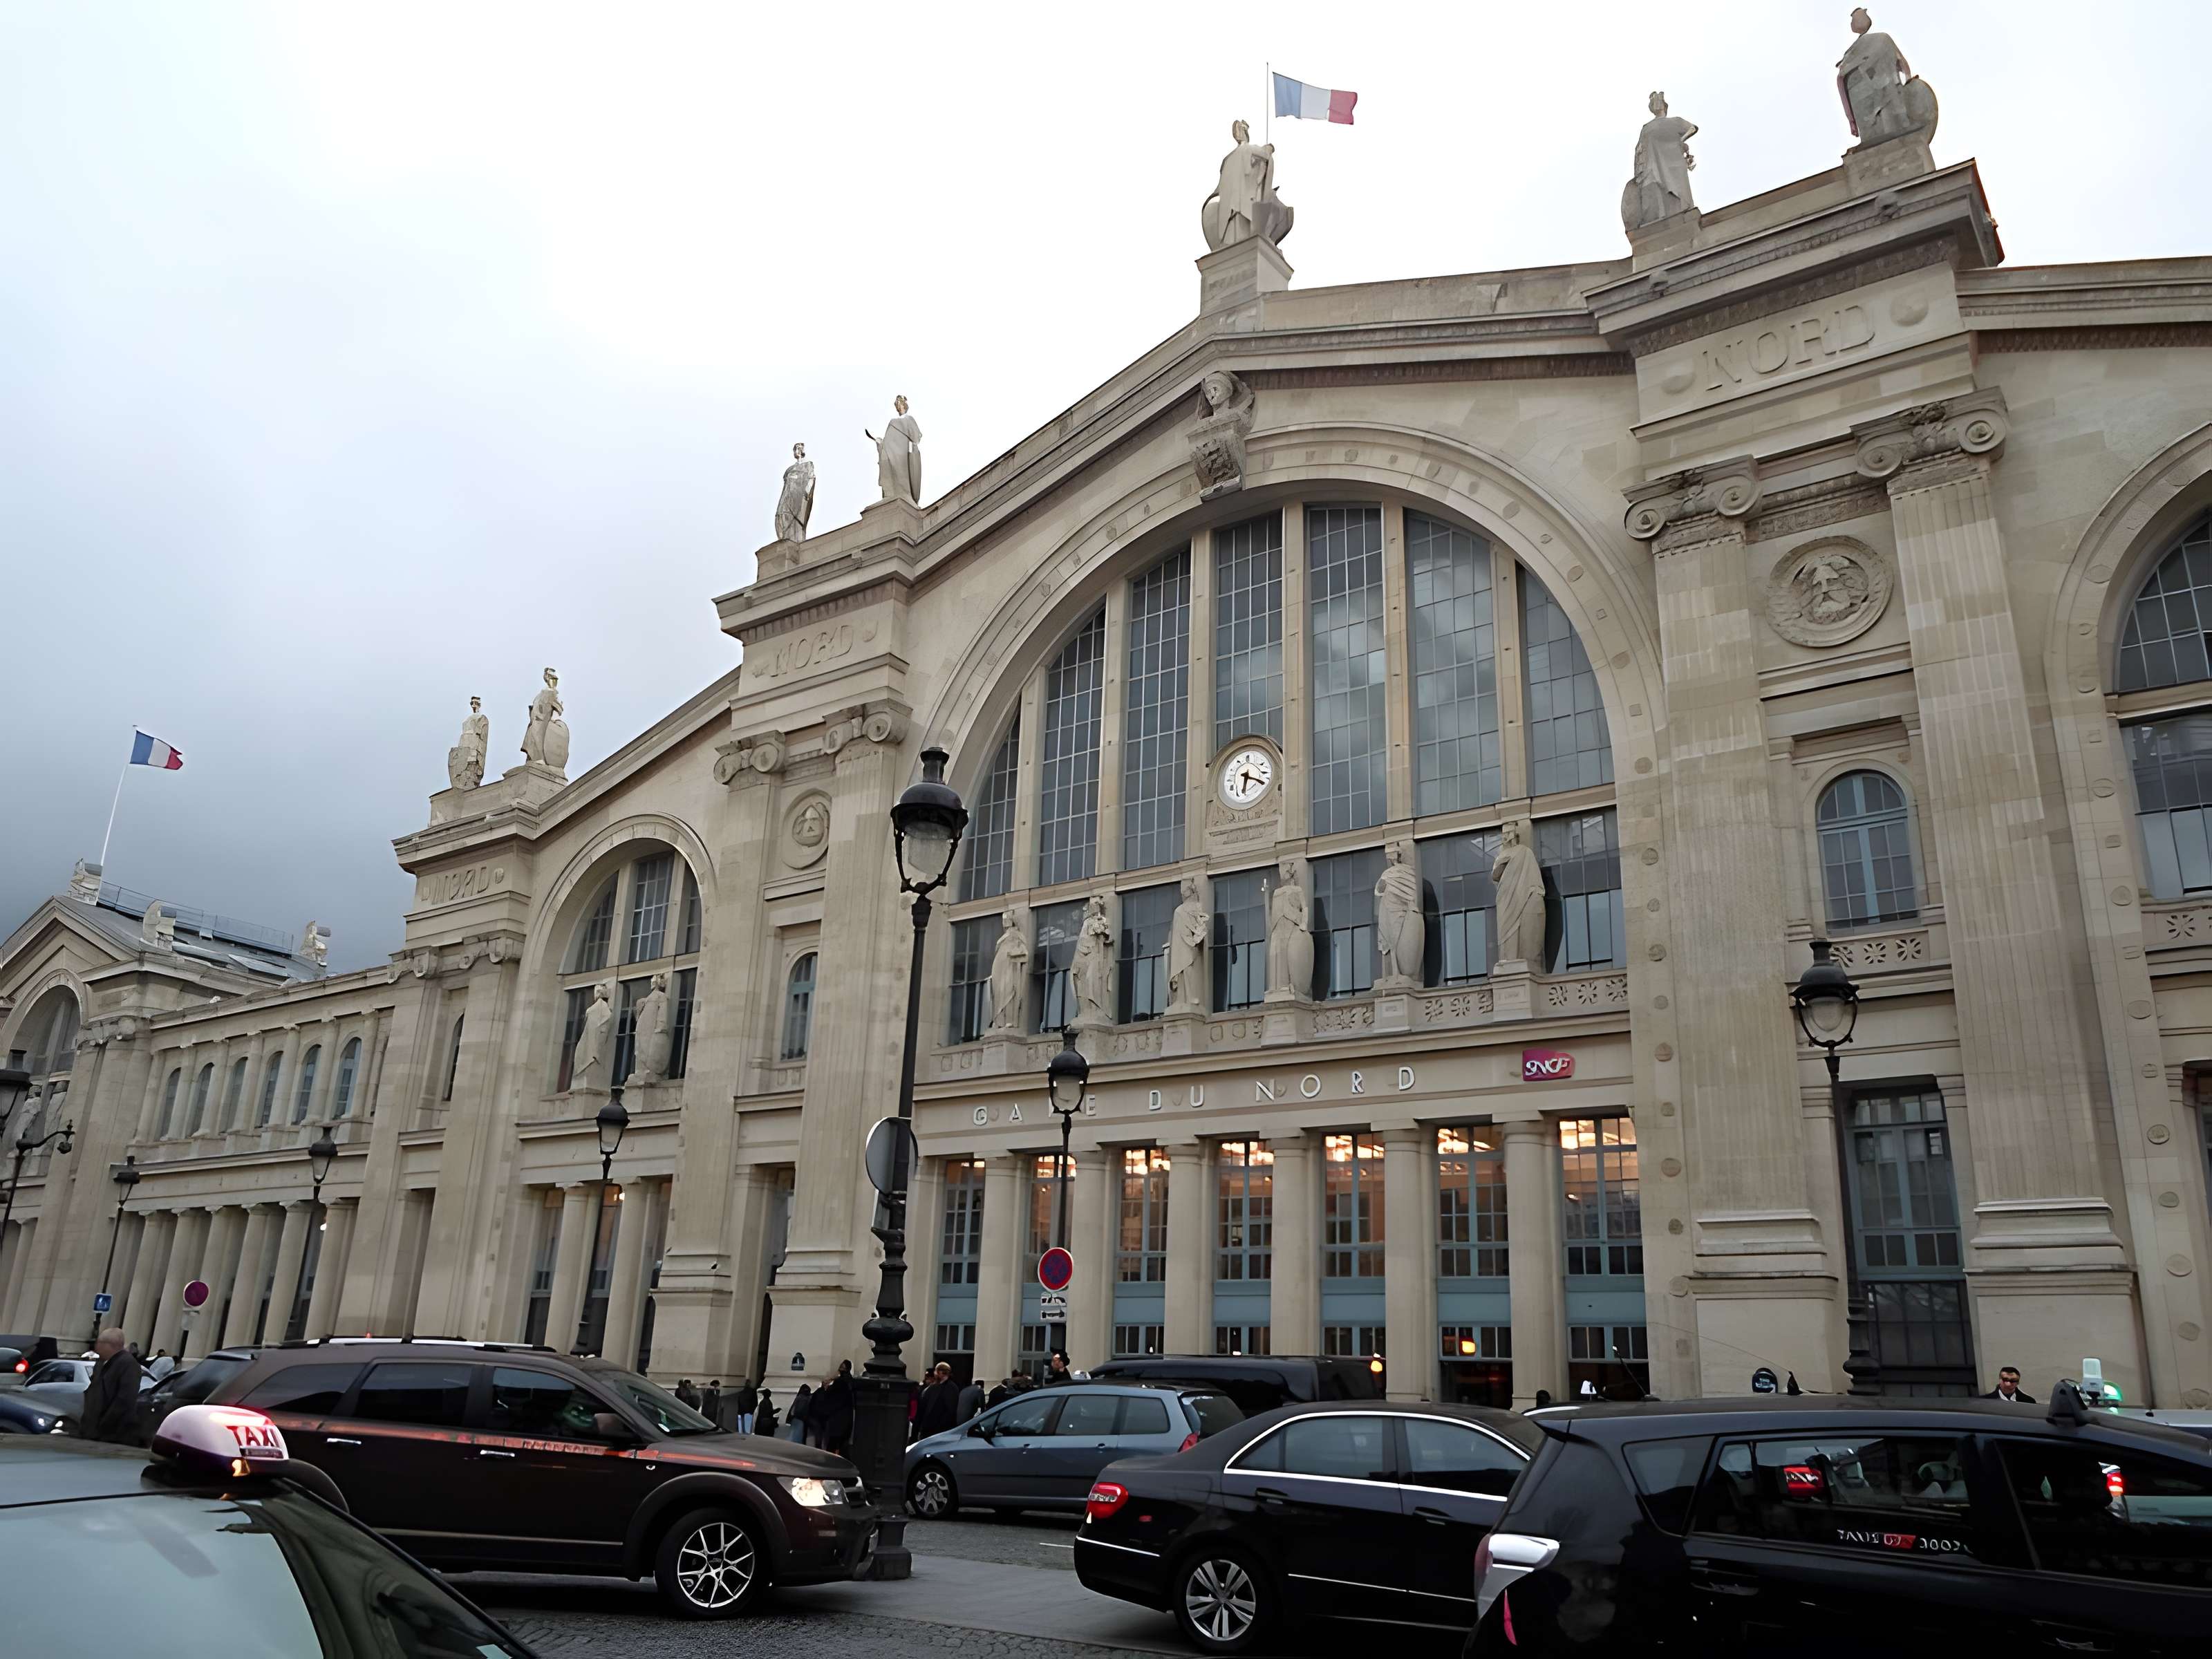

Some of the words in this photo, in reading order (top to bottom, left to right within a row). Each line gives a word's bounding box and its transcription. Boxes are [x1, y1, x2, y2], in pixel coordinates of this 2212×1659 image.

[1703, 305, 1875, 391] NORD
[769, 624, 854, 677] NORD
[1525, 1057, 1571, 1076] SNCF
[973, 1094, 1097, 1126] GAE
[1148, 1084, 1204, 1111] DU
[1255, 1065, 1416, 1103] NORD
[225, 1425, 279, 1447] TAXI
